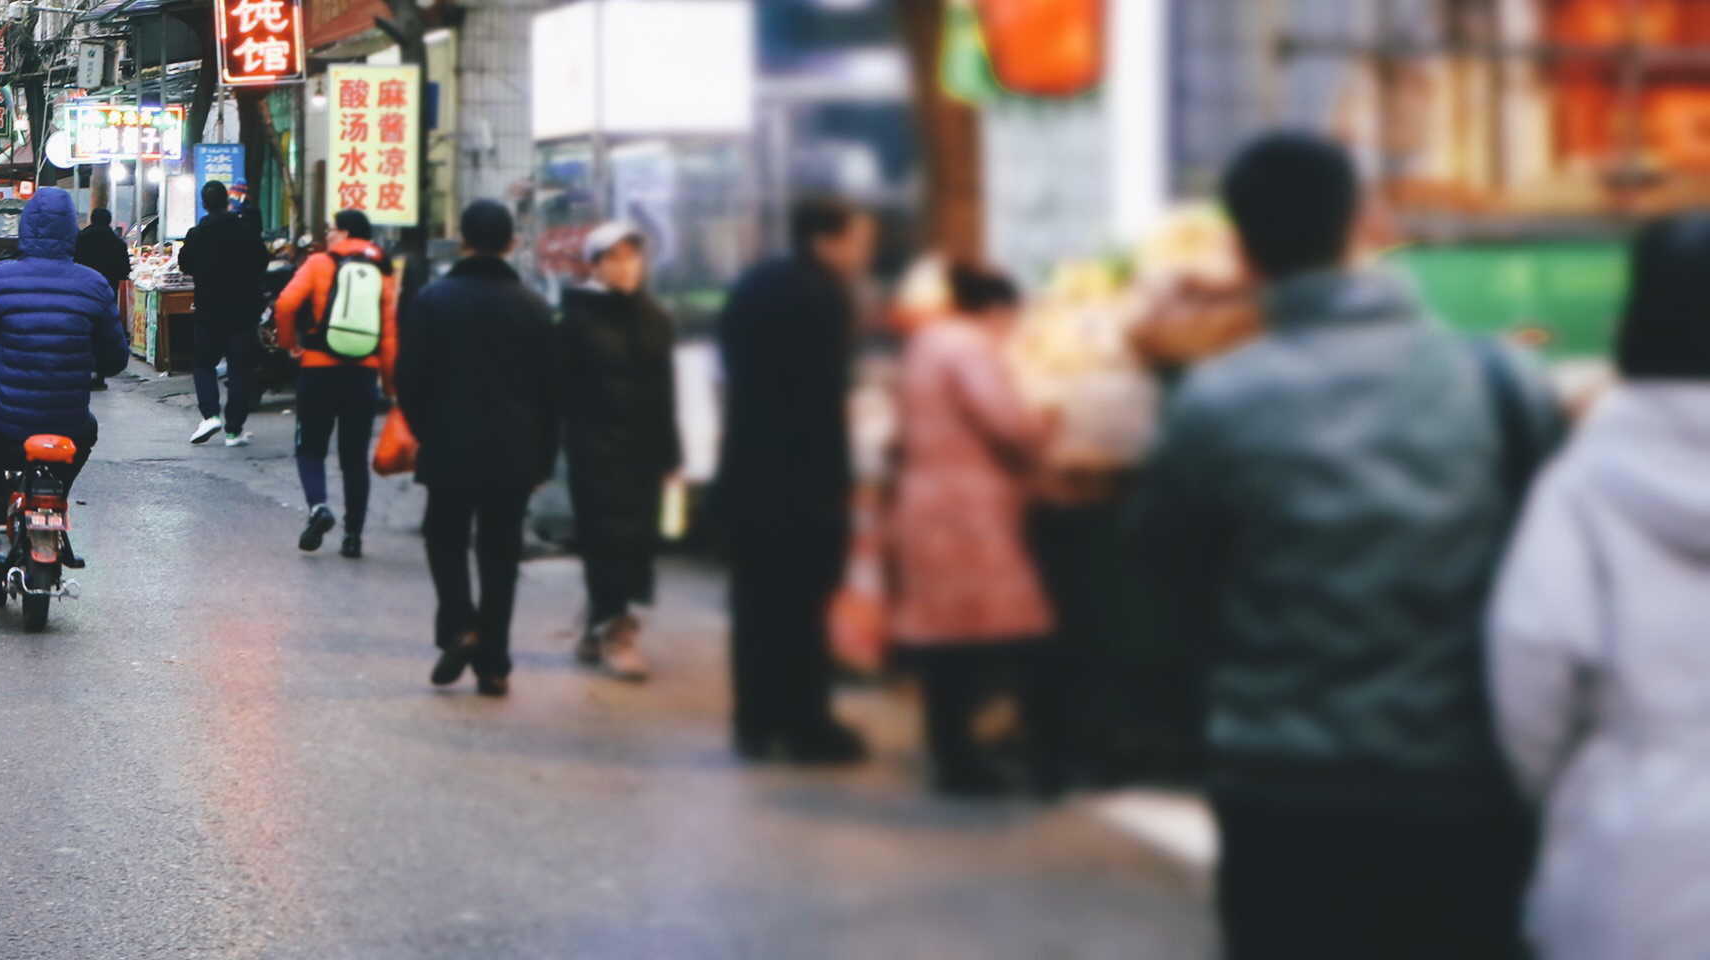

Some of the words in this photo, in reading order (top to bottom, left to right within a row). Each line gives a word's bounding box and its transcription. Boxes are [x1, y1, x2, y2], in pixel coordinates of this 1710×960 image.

[337, 78, 370, 213] 酸汤水饺
[376, 77, 408, 212] 麻酱凉皮
